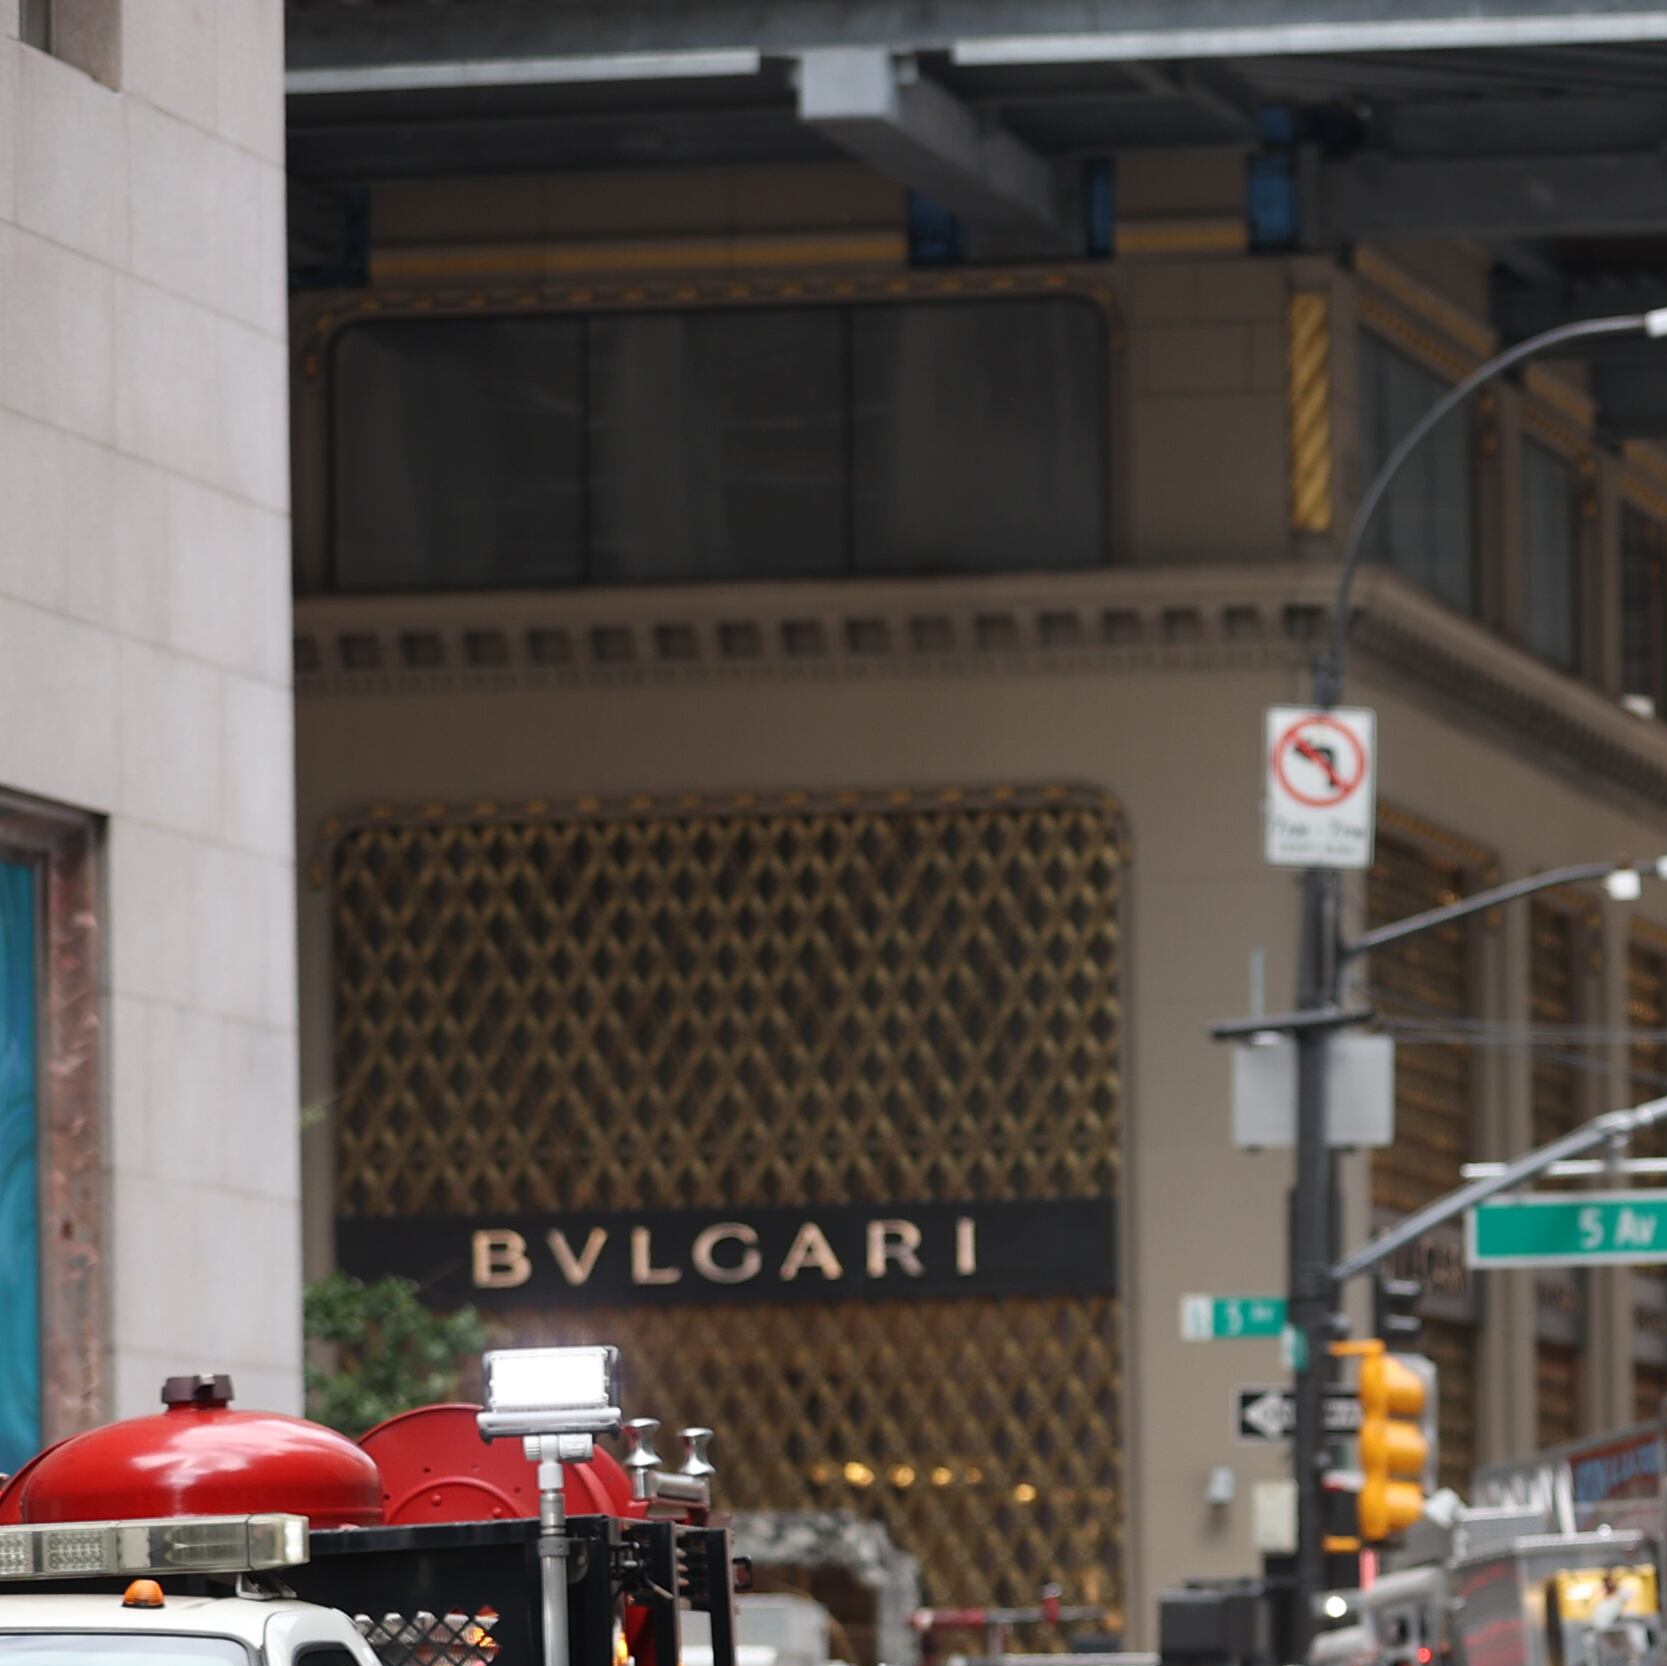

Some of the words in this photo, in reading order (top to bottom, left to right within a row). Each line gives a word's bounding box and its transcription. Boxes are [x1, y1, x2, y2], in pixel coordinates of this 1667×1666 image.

[471, 1215, 977, 1289] BVLGARI
[1578, 1207, 1604, 1249] 5
[1613, 1206, 1656, 1246] Av
